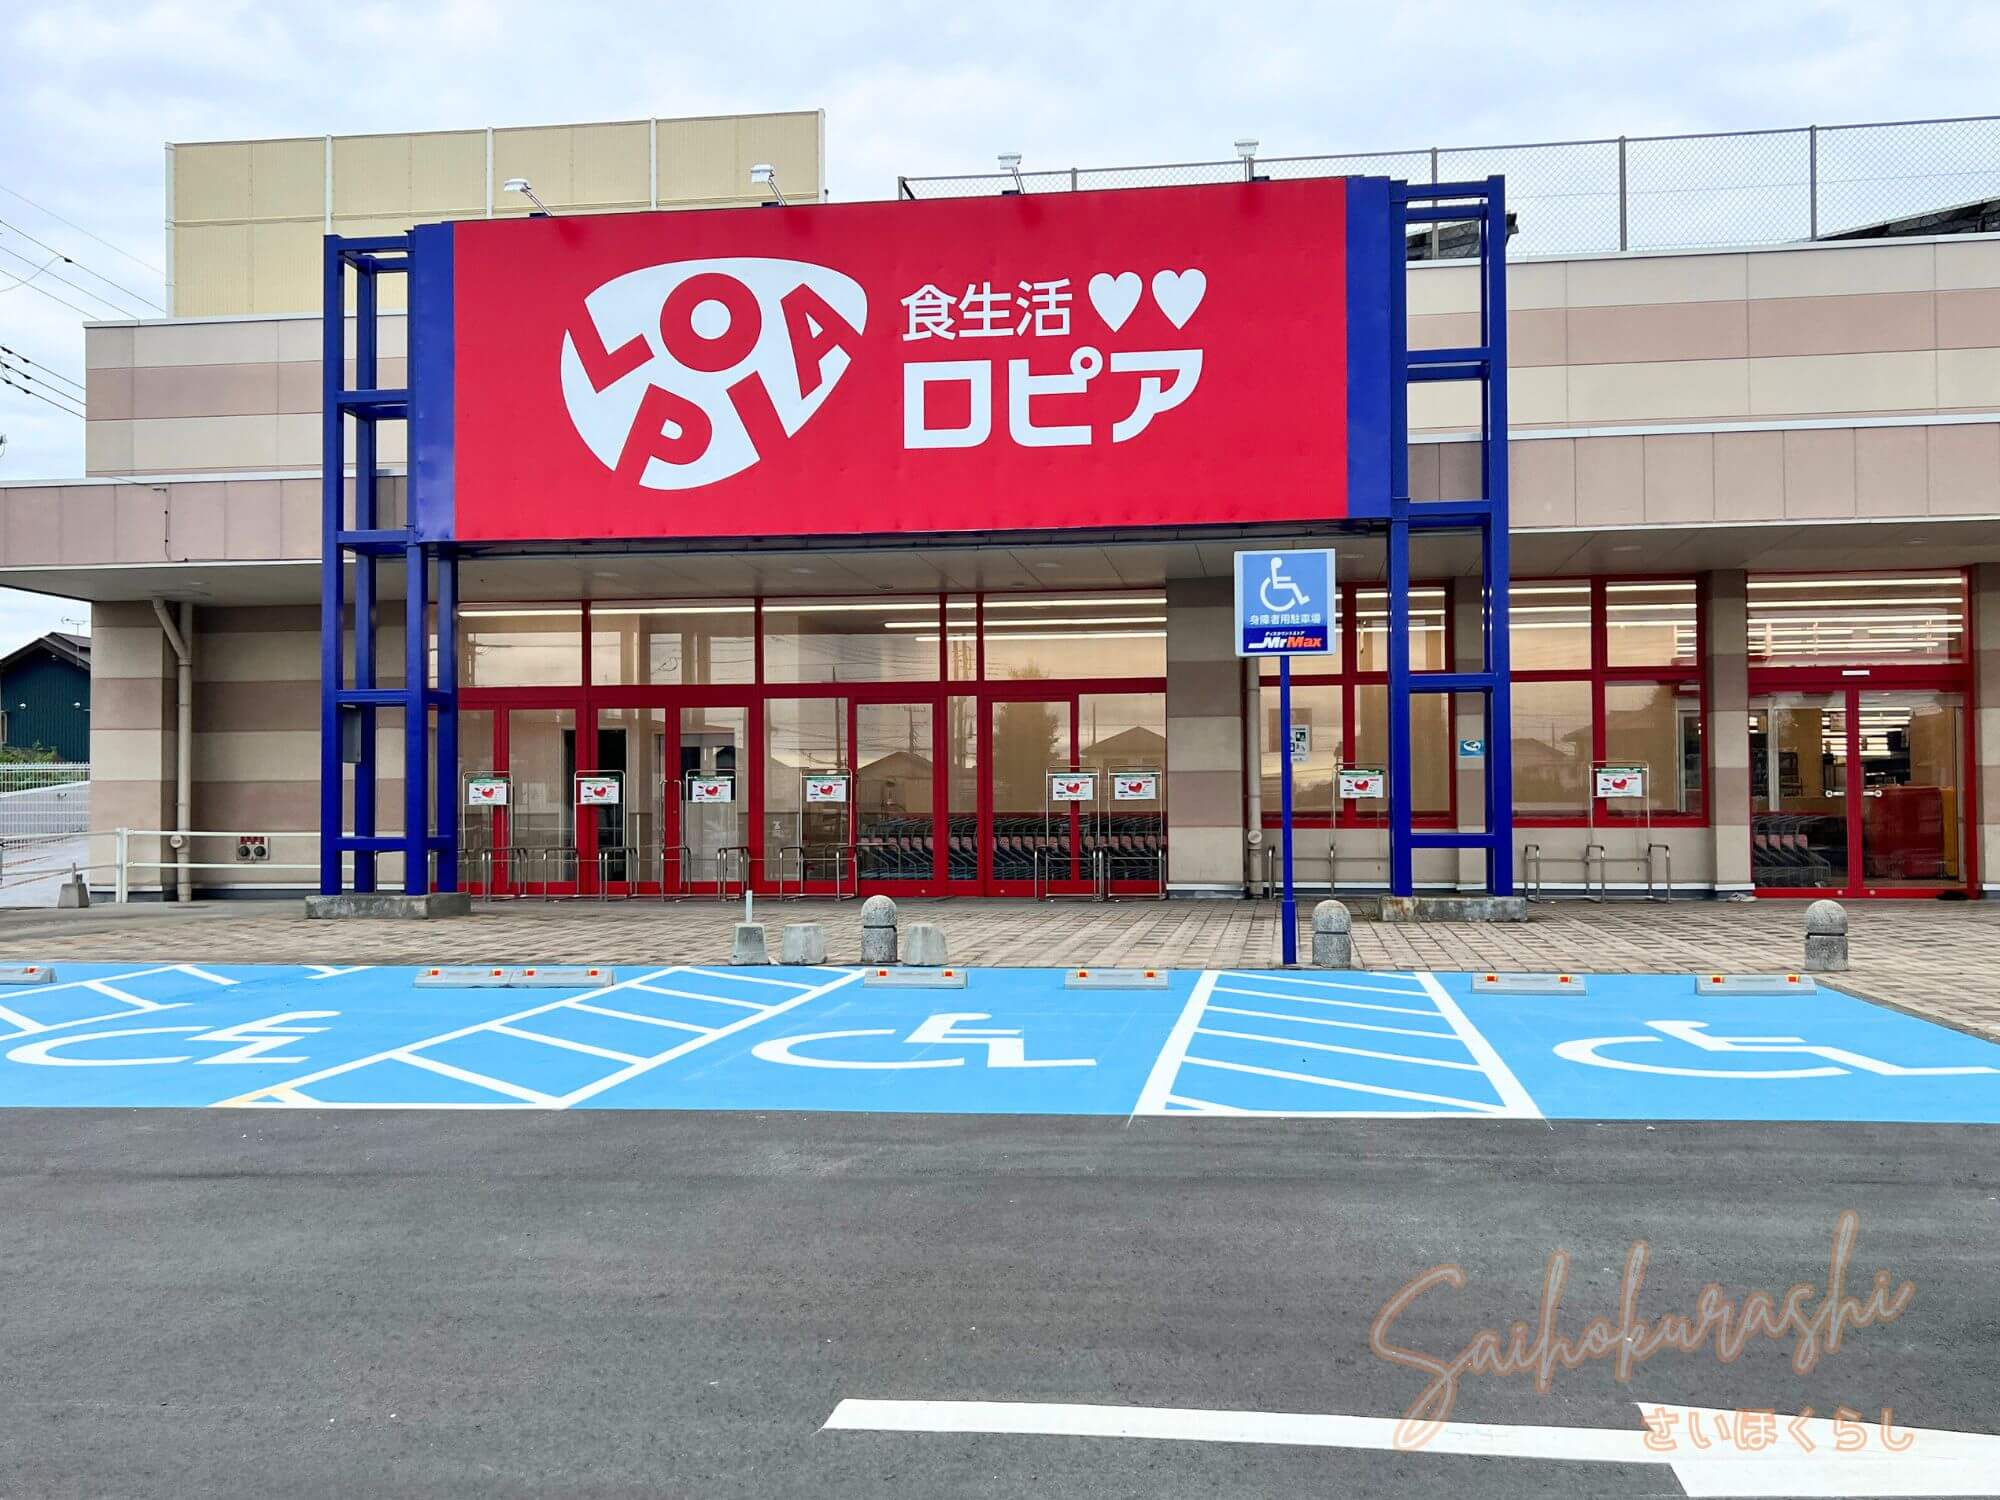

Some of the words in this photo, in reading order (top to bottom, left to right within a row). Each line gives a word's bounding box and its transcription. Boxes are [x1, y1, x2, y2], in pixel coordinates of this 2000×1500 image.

[899, 277, 1074, 342] 食生活
[562, 257, 868, 491] LOPIA
[903, 345, 1204, 449] ロピア
[1248, 636, 1322, 649] MrMax
